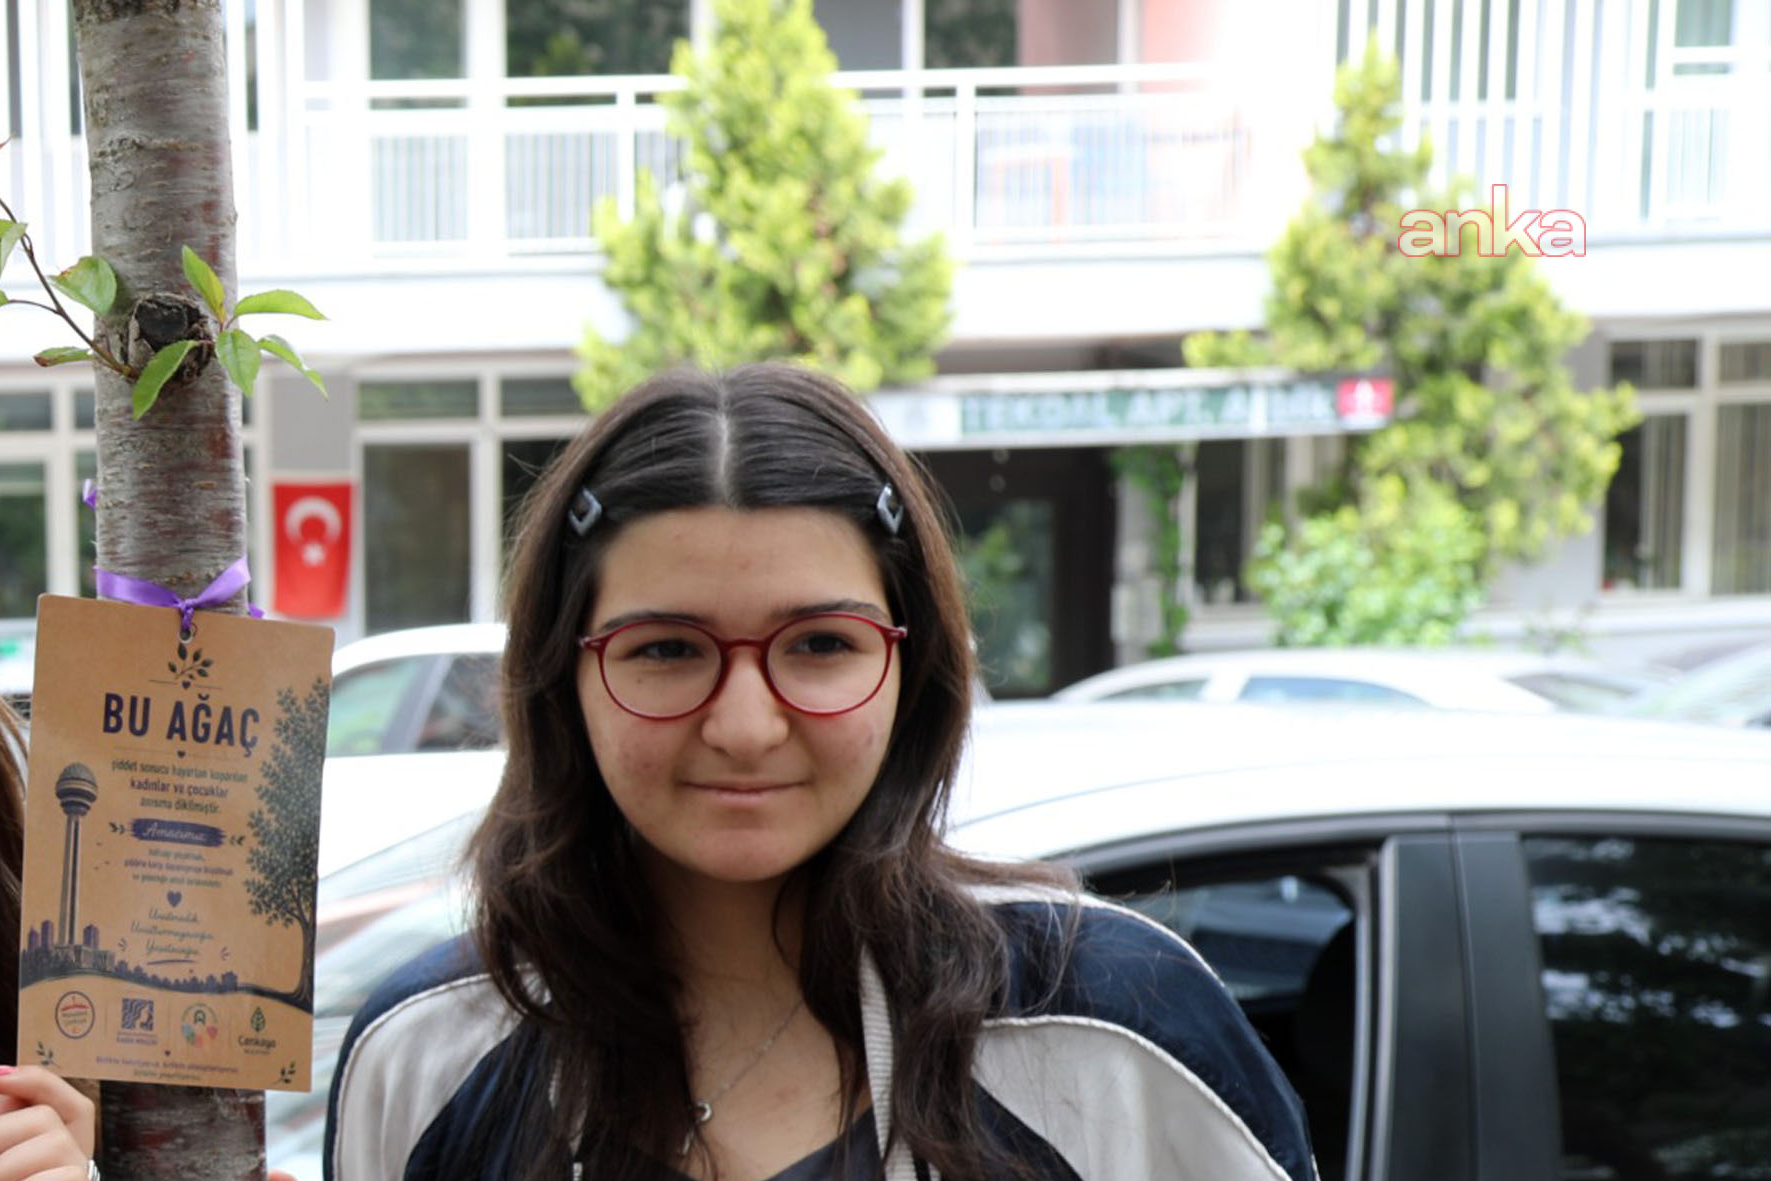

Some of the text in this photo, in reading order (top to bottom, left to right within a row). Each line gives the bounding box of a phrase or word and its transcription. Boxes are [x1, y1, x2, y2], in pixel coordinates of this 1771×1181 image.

[103, 693, 260, 758] BU AĞAÇ
[130, 777, 229, 798] kadınlar ve çocuklar
